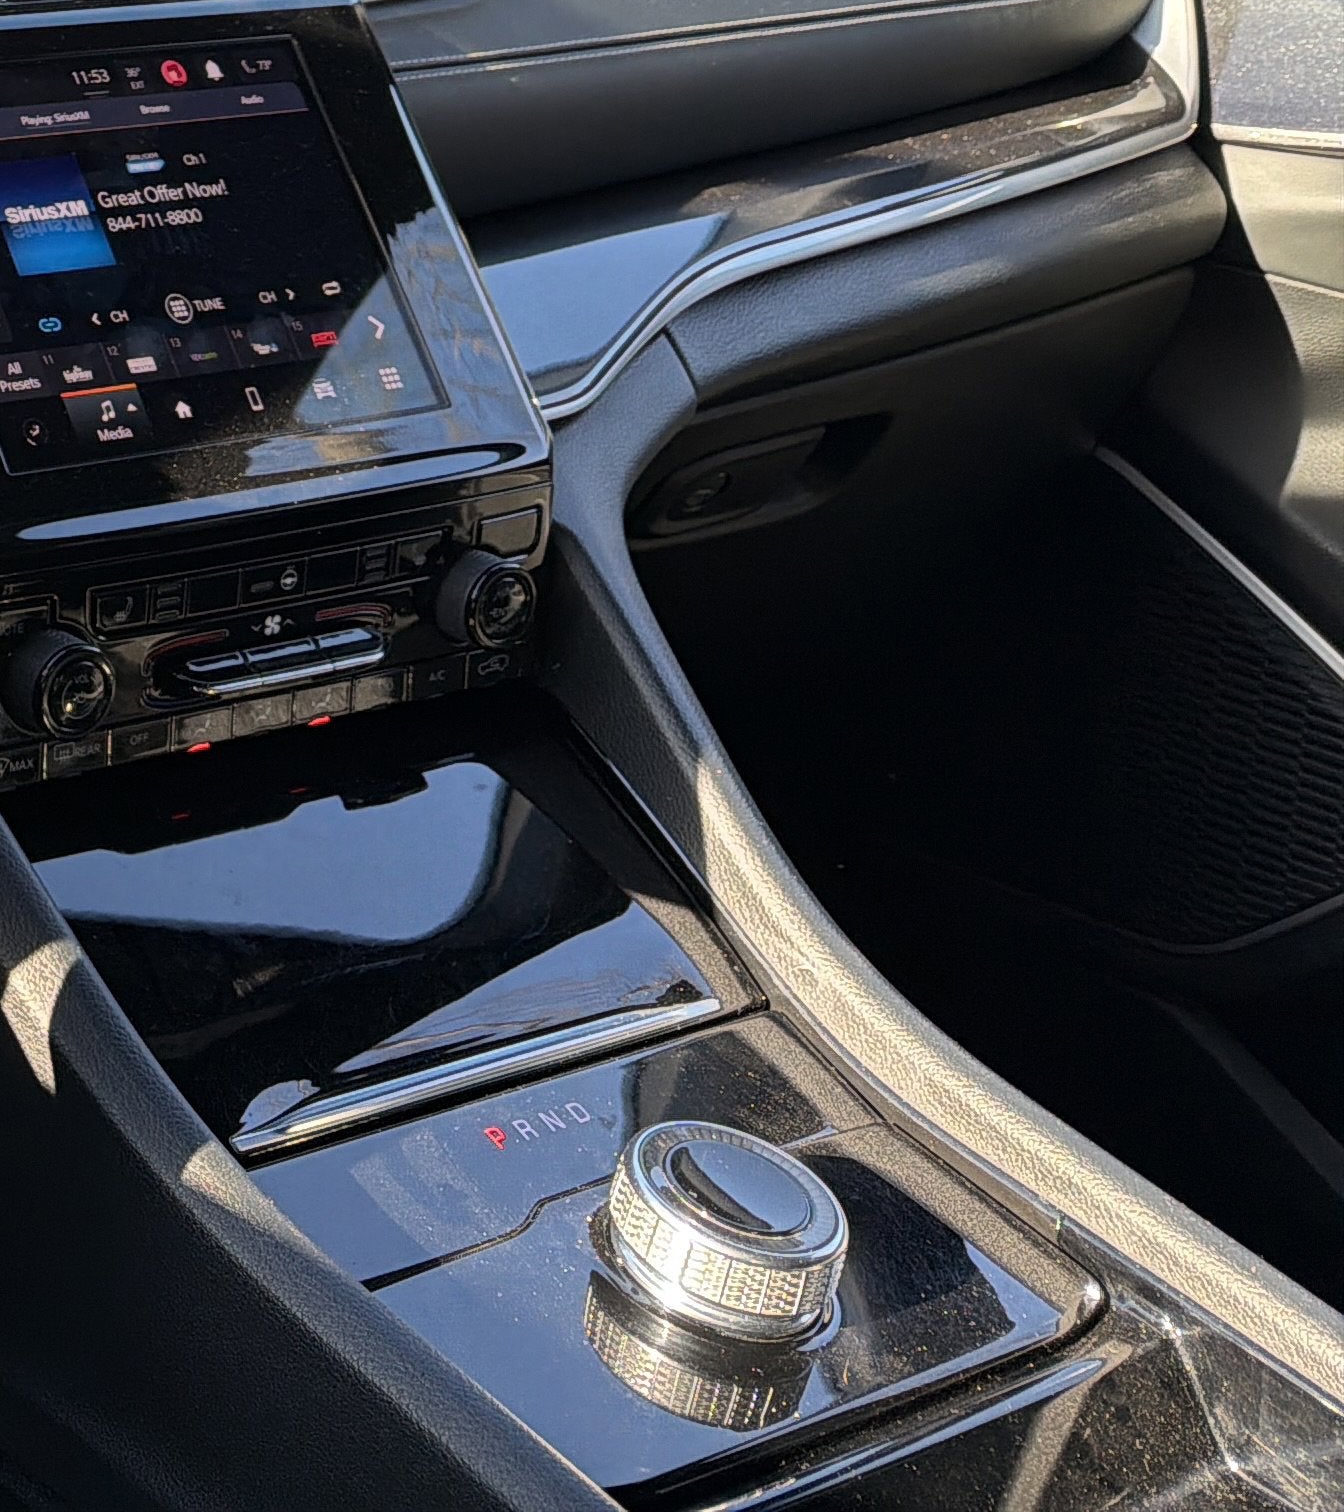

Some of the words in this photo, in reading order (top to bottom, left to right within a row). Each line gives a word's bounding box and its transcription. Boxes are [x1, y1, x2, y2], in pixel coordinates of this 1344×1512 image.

[72, 69, 110, 85] 11:53
[97, 189, 144, 208] Great
[144, 184, 184, 203] Offer
[184, 179, 229, 198] Now!
[4, 199, 89, 224] SiriusXM
[106, 208, 203, 232] 844-711-8800
[192, 297, 226, 312] TUNE
[258, 291, 278, 304] CH
[110, 309, 130, 323] CH
[291, 321, 304, 332] 15
[231, 329, 243, 340] 14
[169, 337, 182, 348] 13
[107, 345, 119, 356] 12
[7, 362, 23, 375] All
[0, 377, 42, 393] Presets
[97, 425, 134, 442] Media
[129, 732, 150, 745] OFF
[9, 758, 36, 773] MAX
[484, 1127, 507, 1151] P
[512, 1119, 540, 1141] R
[538, 1109, 567, 1132] N
[564, 1102, 591, 1124] D
